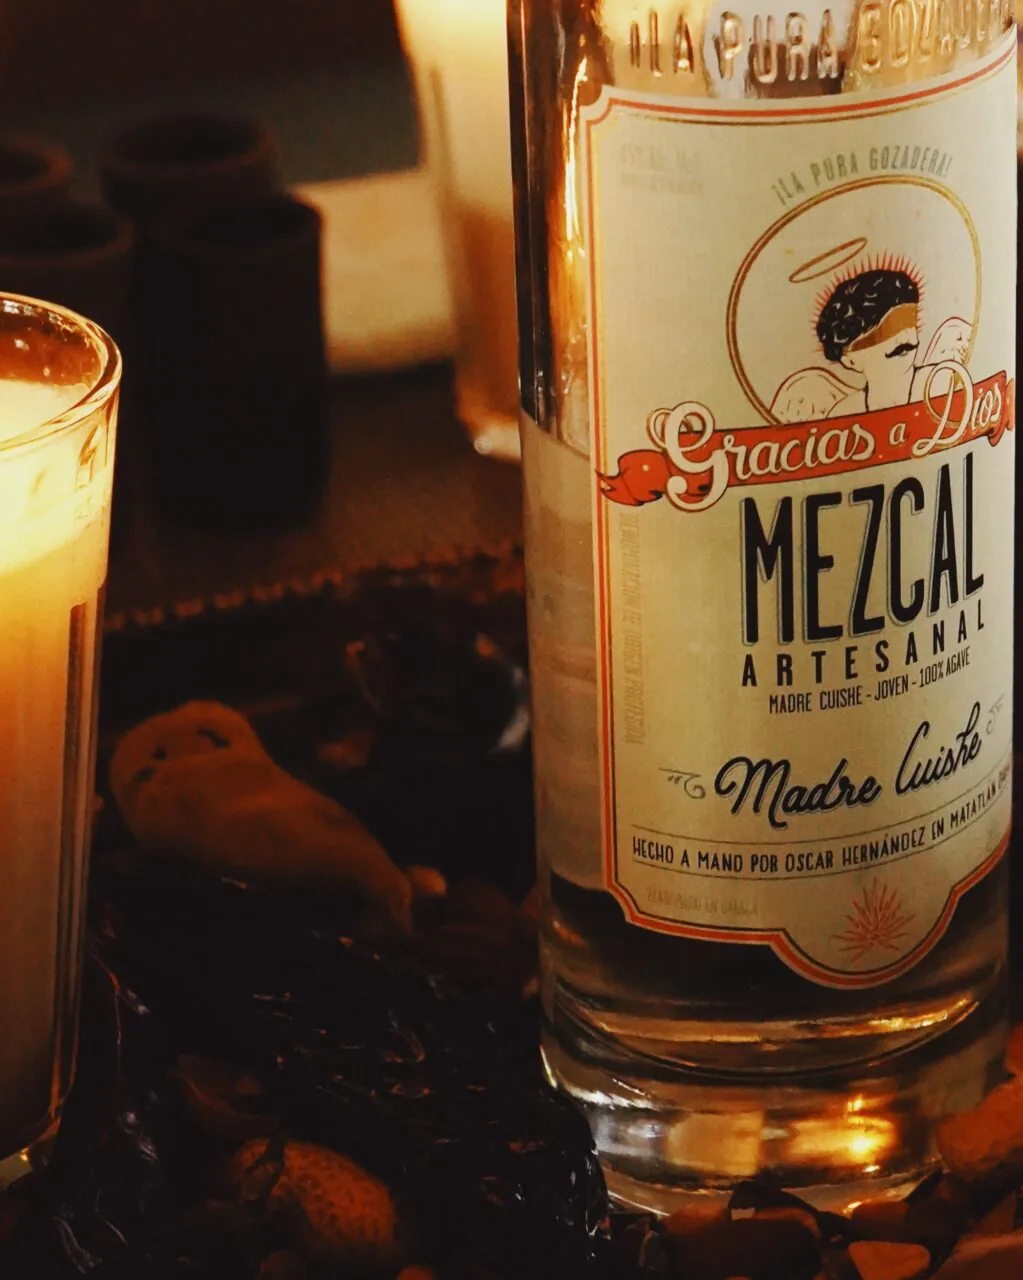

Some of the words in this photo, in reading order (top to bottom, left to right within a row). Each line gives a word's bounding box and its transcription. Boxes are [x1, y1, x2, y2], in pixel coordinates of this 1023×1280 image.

[714, 8, 839, 83] PURA
[810, 151, 859, 187] PURA
[869, 145, 953, 179] GOZADERA!
[646, 400, 875, 512] Gracias
[888, 420, 907, 446] a
[911, 361, 1003, 460] Dios
[739, 452, 985, 647] MEZCAL
[741, 599, 985, 687] ARTESANAL
[769, 693, 812, 714] MADRE
[820, 685, 863, 710] CUISHE
[874, 674, 909, 701] JOVEN
[919, 661, 944, 688] 100%
[946, 646, 970, 677] AGAVE
[714, 756, 883, 830] Madre
[895, 701, 982, 796] Cuishe
[632, 836, 674, 864] HECHO
[680, 849, 690, 868] A
[698, 851, 744, 873] MANO
[751, 854, 778, 873] POR
[785, 850, 834, 872] OSCAR
[842, 826, 926, 867] HERNÁNDEZ
[931, 817, 945, 841] EN
